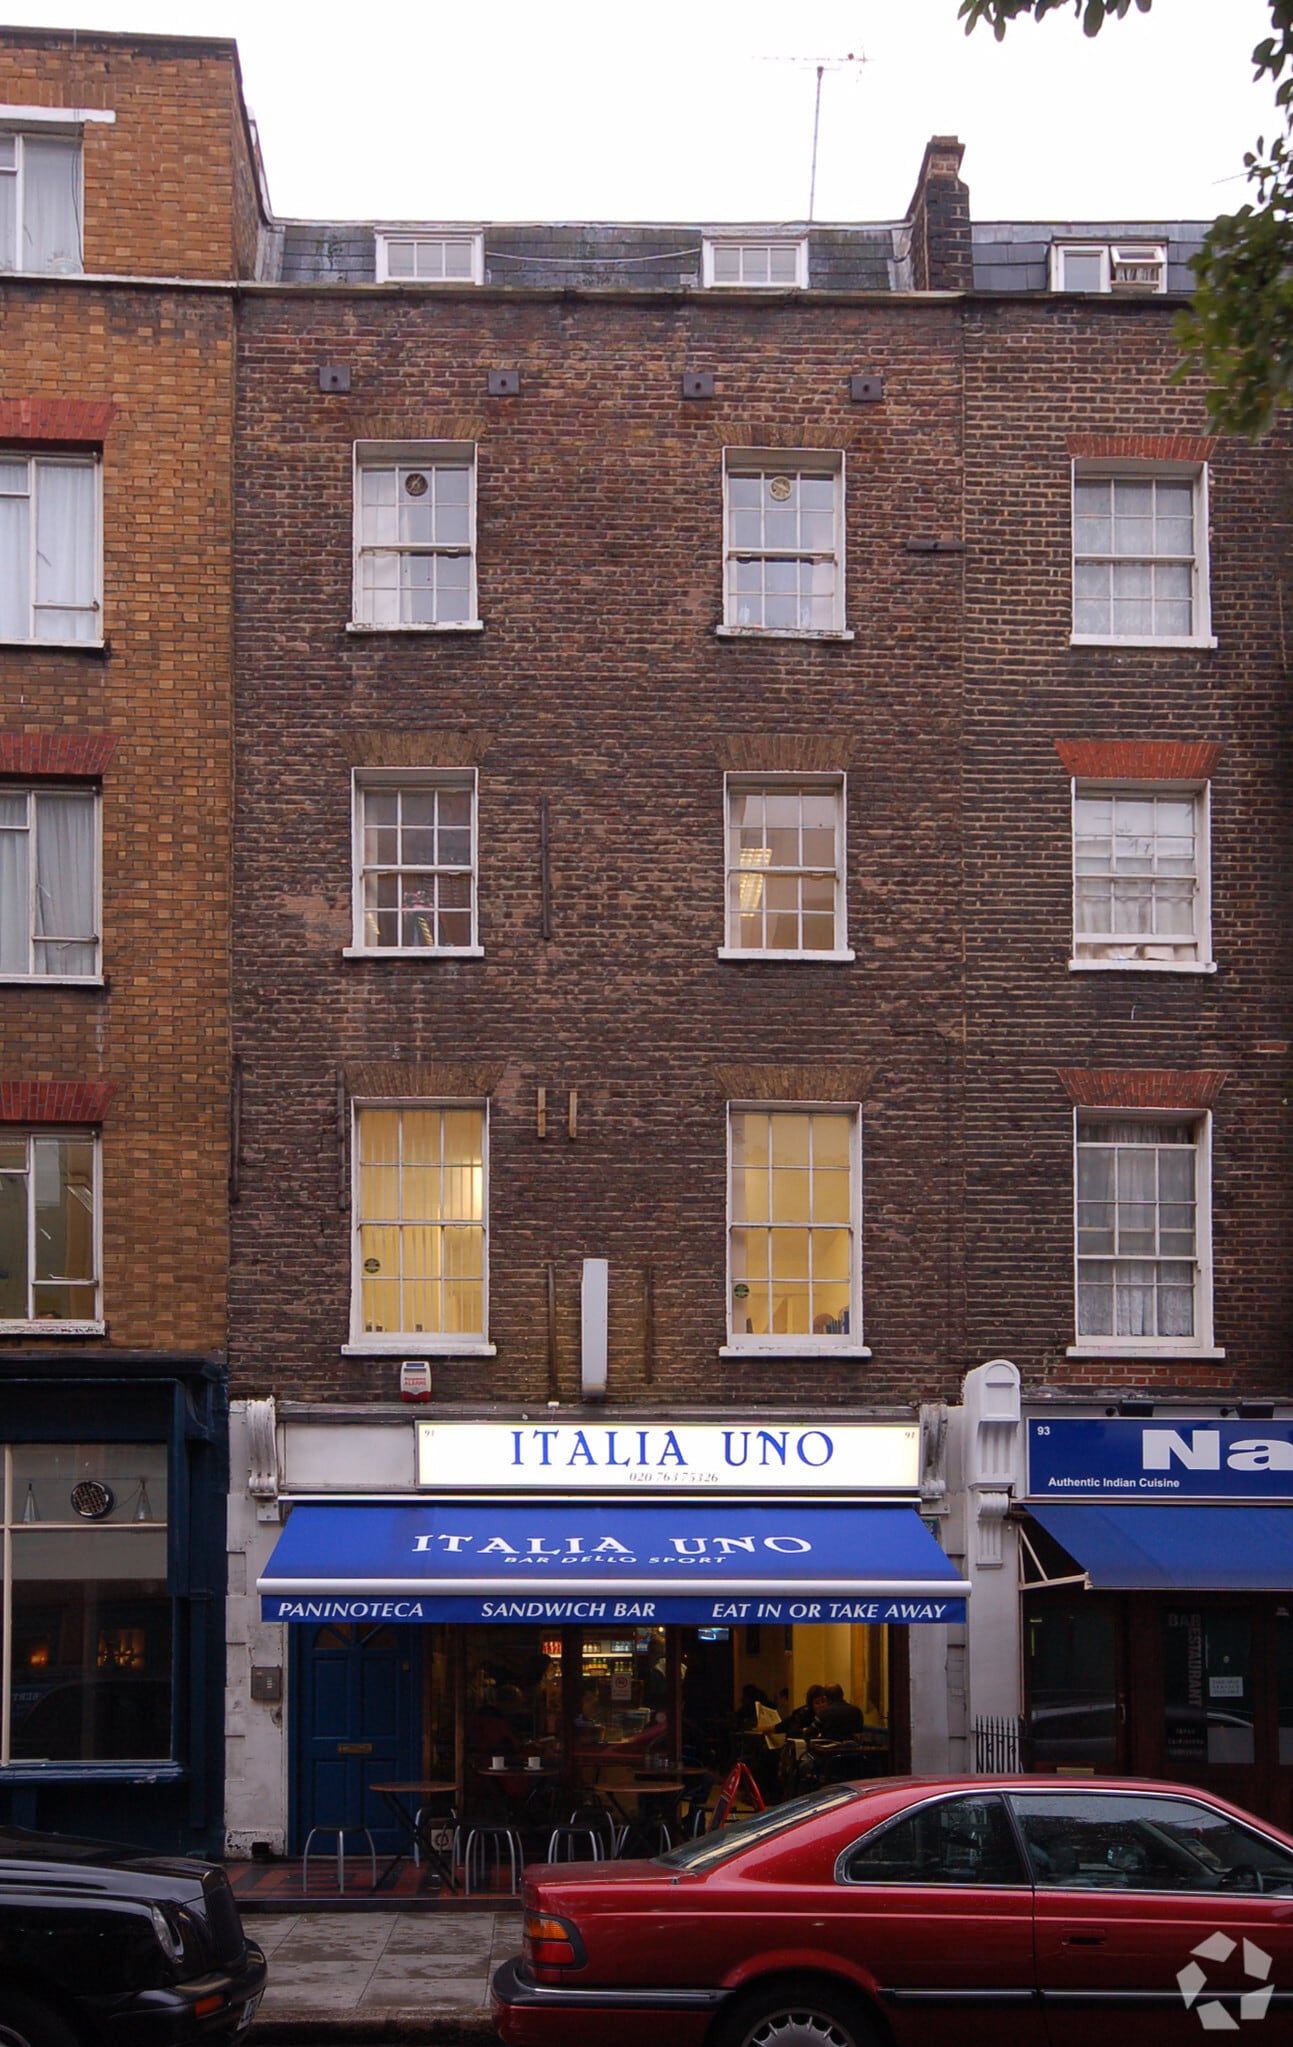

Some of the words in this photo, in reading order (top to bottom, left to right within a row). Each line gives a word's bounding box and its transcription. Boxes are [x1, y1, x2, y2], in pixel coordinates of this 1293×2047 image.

[1037, 1426, 1051, 1436] 93
[512, 1430, 688, 1466] ITALIA
[722, 1431, 834, 1466] UNO
[1048, 1477, 1100, 1488] Authentic
[1103, 1477, 1136, 1488] Indian
[1139, 1478, 1180, 1488] Cuisine
[412, 1535, 633, 1554] ITALIA
[669, 1536, 812, 1554] UNO
[504, 1556, 550, 1564] BAR
[561, 1555, 637, 1564] DELLO
[649, 1556, 726, 1564] SPORT
[278, 1602, 423, 1617] PANINOTECA
[481, 1602, 606, 1617] SANDWICH
[613, 1603, 656, 1617] BAR
[712, 1603, 751, 1618] EAT
[757, 1604, 782, 1618] IN
[789, 1604, 821, 1618] OR
[829, 1604, 879, 1618] TAKE
[884, 1604, 946, 1619] AWAY
